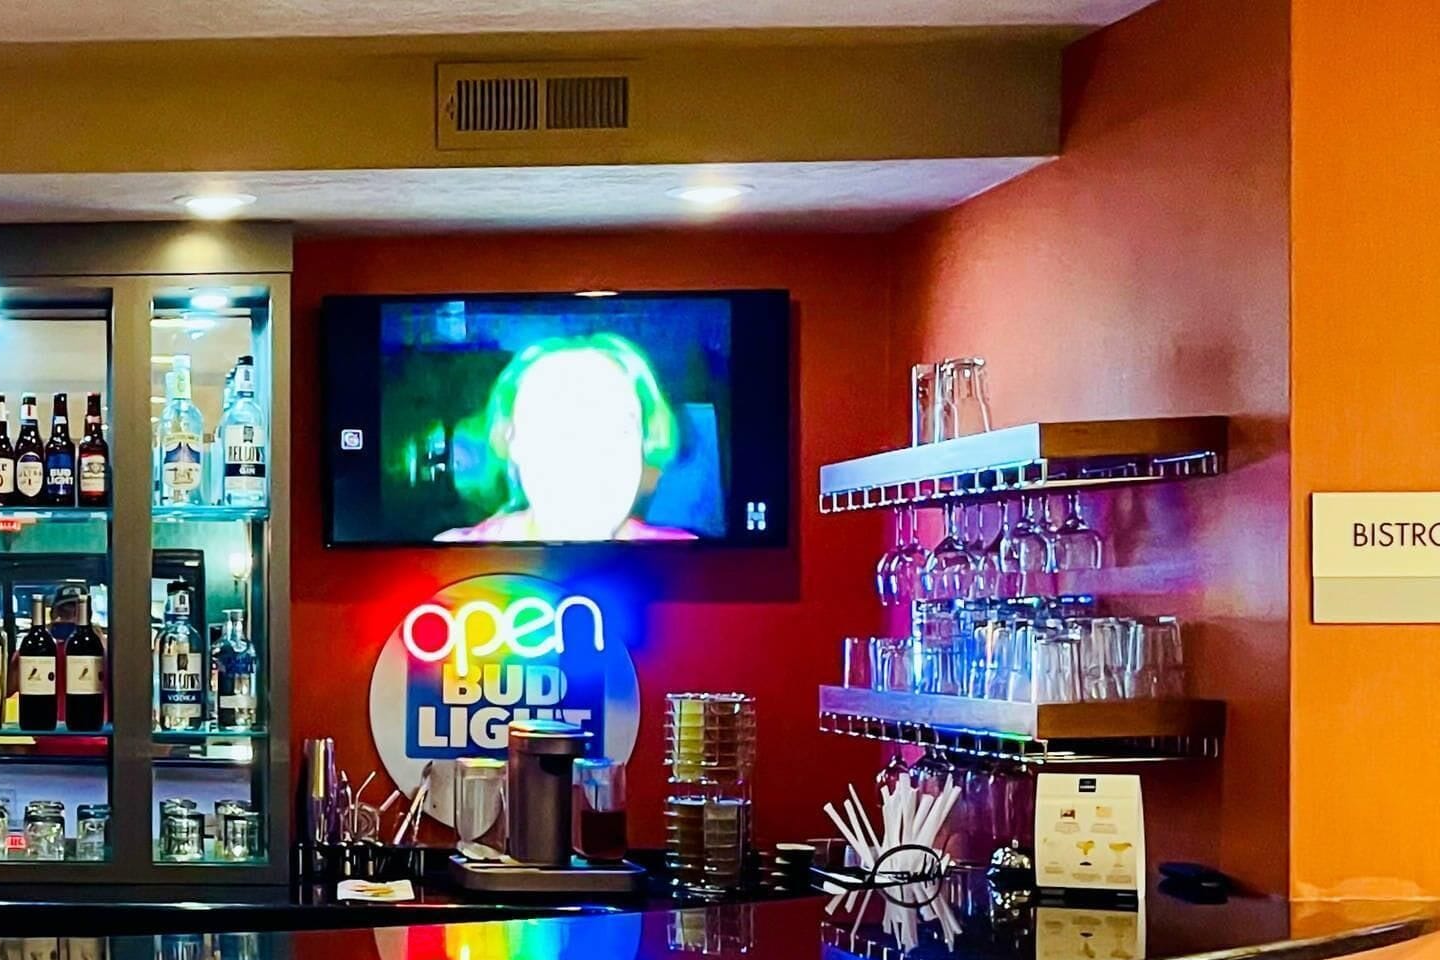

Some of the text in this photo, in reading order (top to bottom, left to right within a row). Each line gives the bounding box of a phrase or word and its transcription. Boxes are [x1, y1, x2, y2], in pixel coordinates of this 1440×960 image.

[47, 476, 74, 485] LIGHT
[50, 468, 72, 476] BUD
[403, 595, 604, 677] open
[443, 664, 568, 705] BUD
